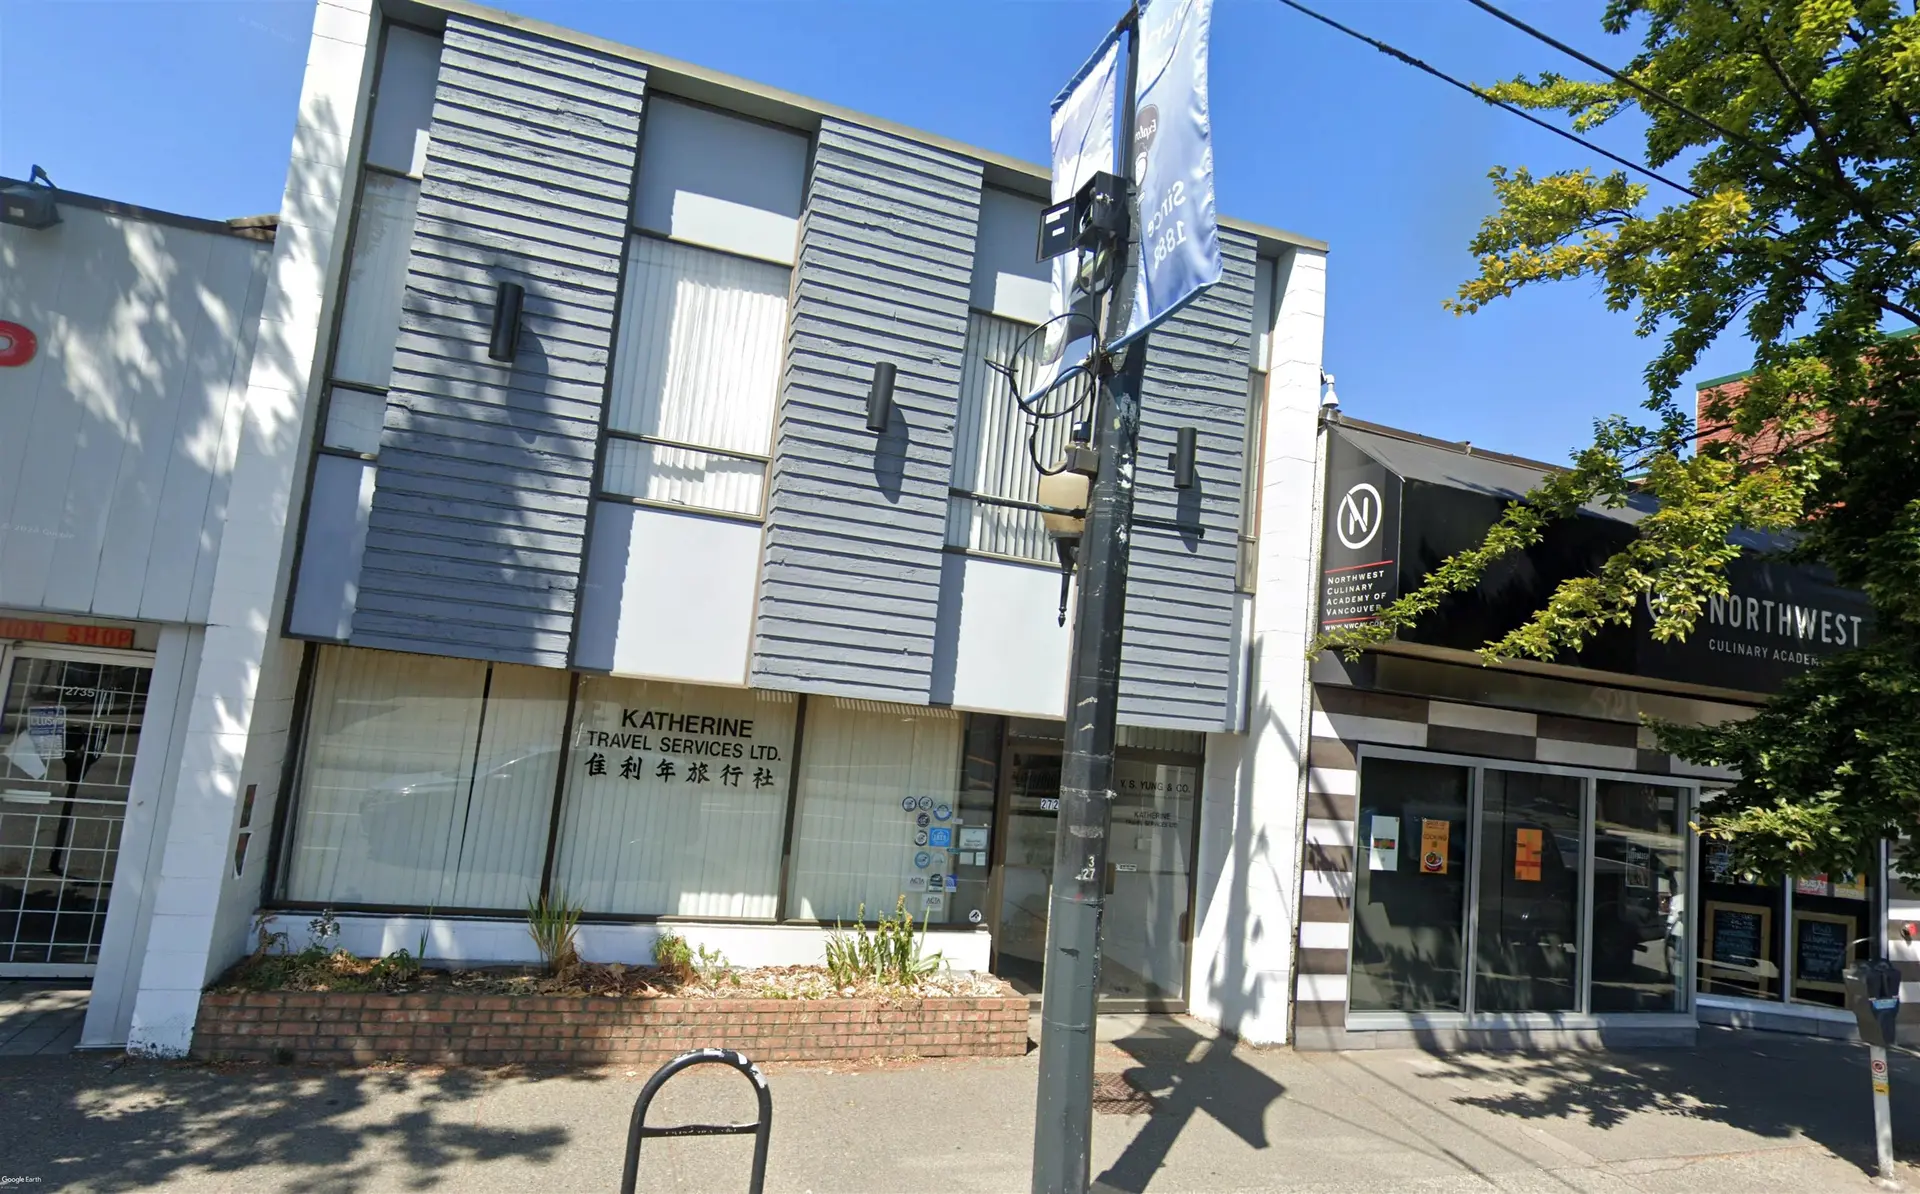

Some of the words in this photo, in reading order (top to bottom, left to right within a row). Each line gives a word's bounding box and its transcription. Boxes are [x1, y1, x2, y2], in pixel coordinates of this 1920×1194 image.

[1327, 569, 1385, 585] NORTHWEST
[1326, 582, 1373, 596] CULINARY
[1326, 594, 1370, 606] ACADEMY
[1373, 592, 1387, 600] OF
[1709, 593, 1862, 648] NORTHWEST
[66, 626, 131, 649] SHOP
[1708, 638, 1769, 659] CULINARY
[1772, 649, 1820, 667] ACADEM
[65, 686, 95, 698] 2735
[621, 708, 754, 739] KATHERINE
[587, 730, 652, 752] TRAVEL
[659, 736, 744, 759] SERVICES
[749, 744, 782, 762] LTD.
[1140, 781, 1164, 791] YUNG
[1166, 783, 1173, 792] &
[1175, 783, 1191, 793] CO.
[1041, 799, 1059, 810] 272
[1088, 854, 1096, 868] 3
[909, 877, 925, 885] ACTA
[1082, 868, 1096, 880] 27
[925, 896, 941, 905] ACTA
